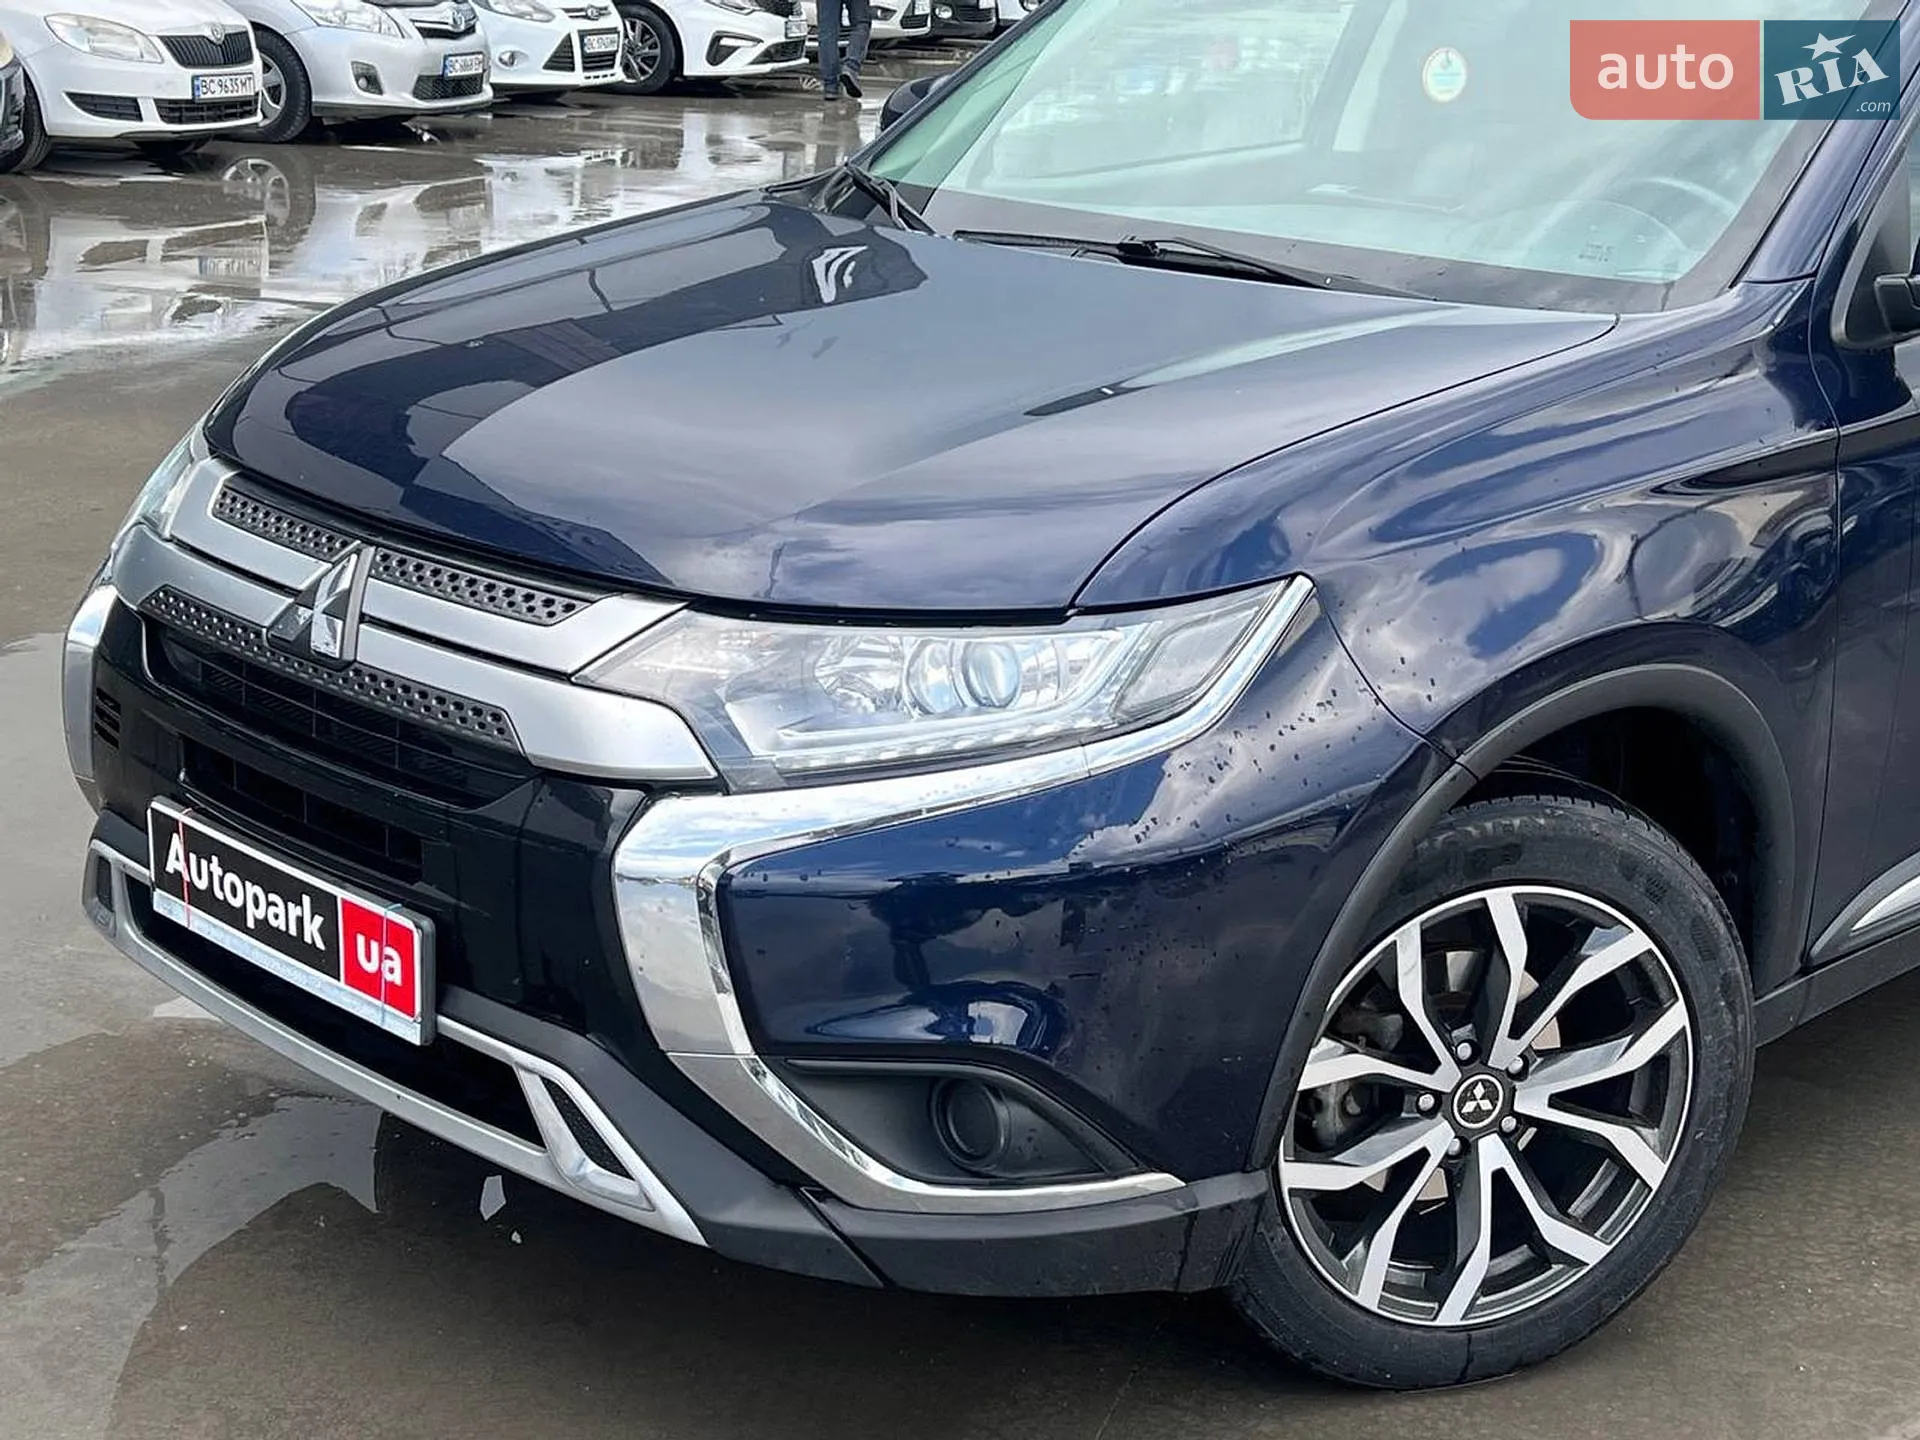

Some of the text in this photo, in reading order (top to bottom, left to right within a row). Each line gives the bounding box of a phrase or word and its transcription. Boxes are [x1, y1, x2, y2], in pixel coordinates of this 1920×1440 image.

[201, 79, 216, 95] BC
[217, 78, 240, 94] 9635
[165, 832, 402, 986] Autopark ua
